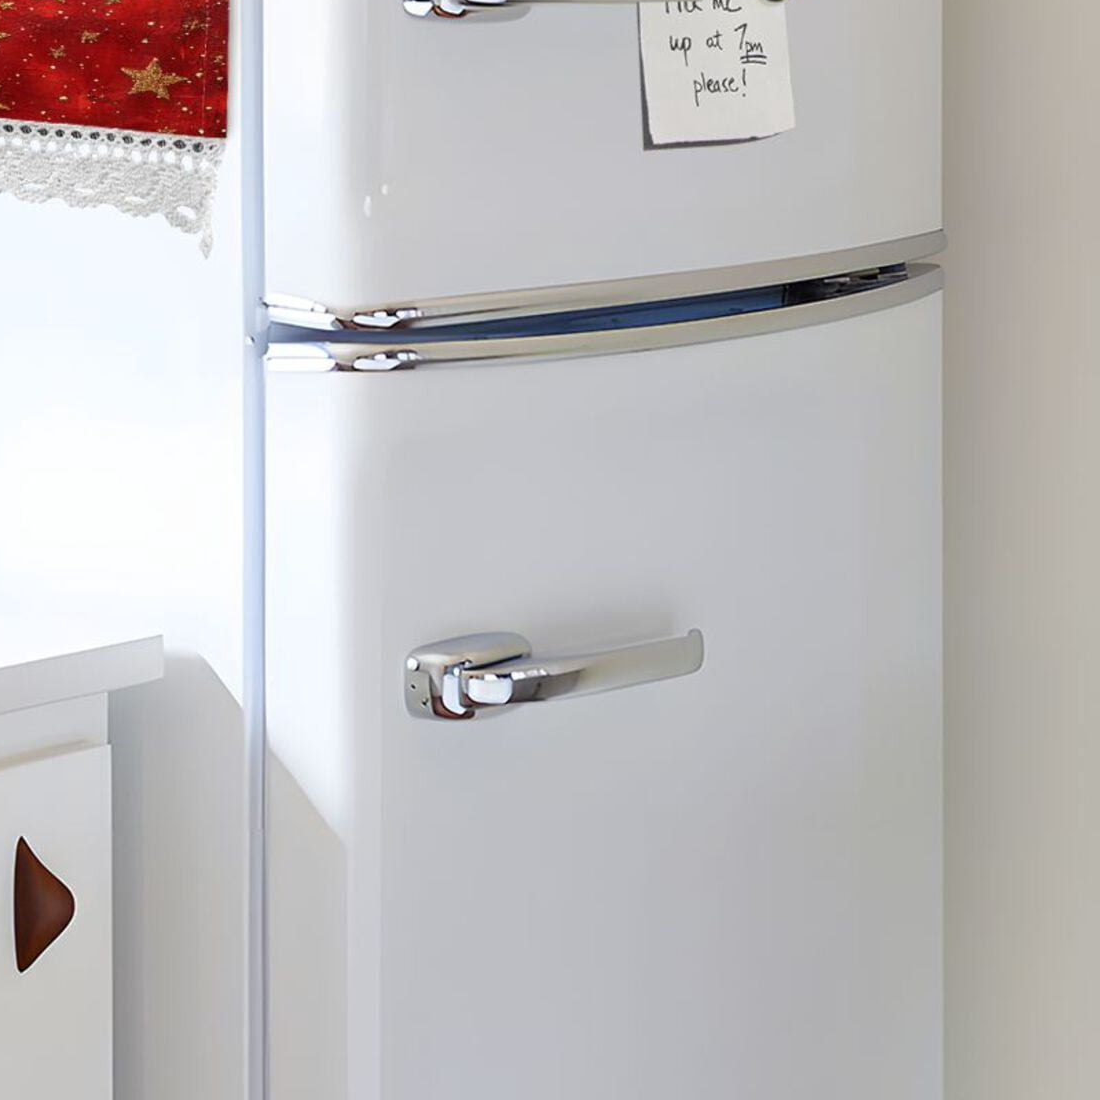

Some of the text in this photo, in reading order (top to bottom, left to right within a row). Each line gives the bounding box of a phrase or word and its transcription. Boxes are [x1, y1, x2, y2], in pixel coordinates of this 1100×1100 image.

[669, 35, 692, 67] up
[706, 30, 723, 51] at
[694, 68, 747, 107] please!
